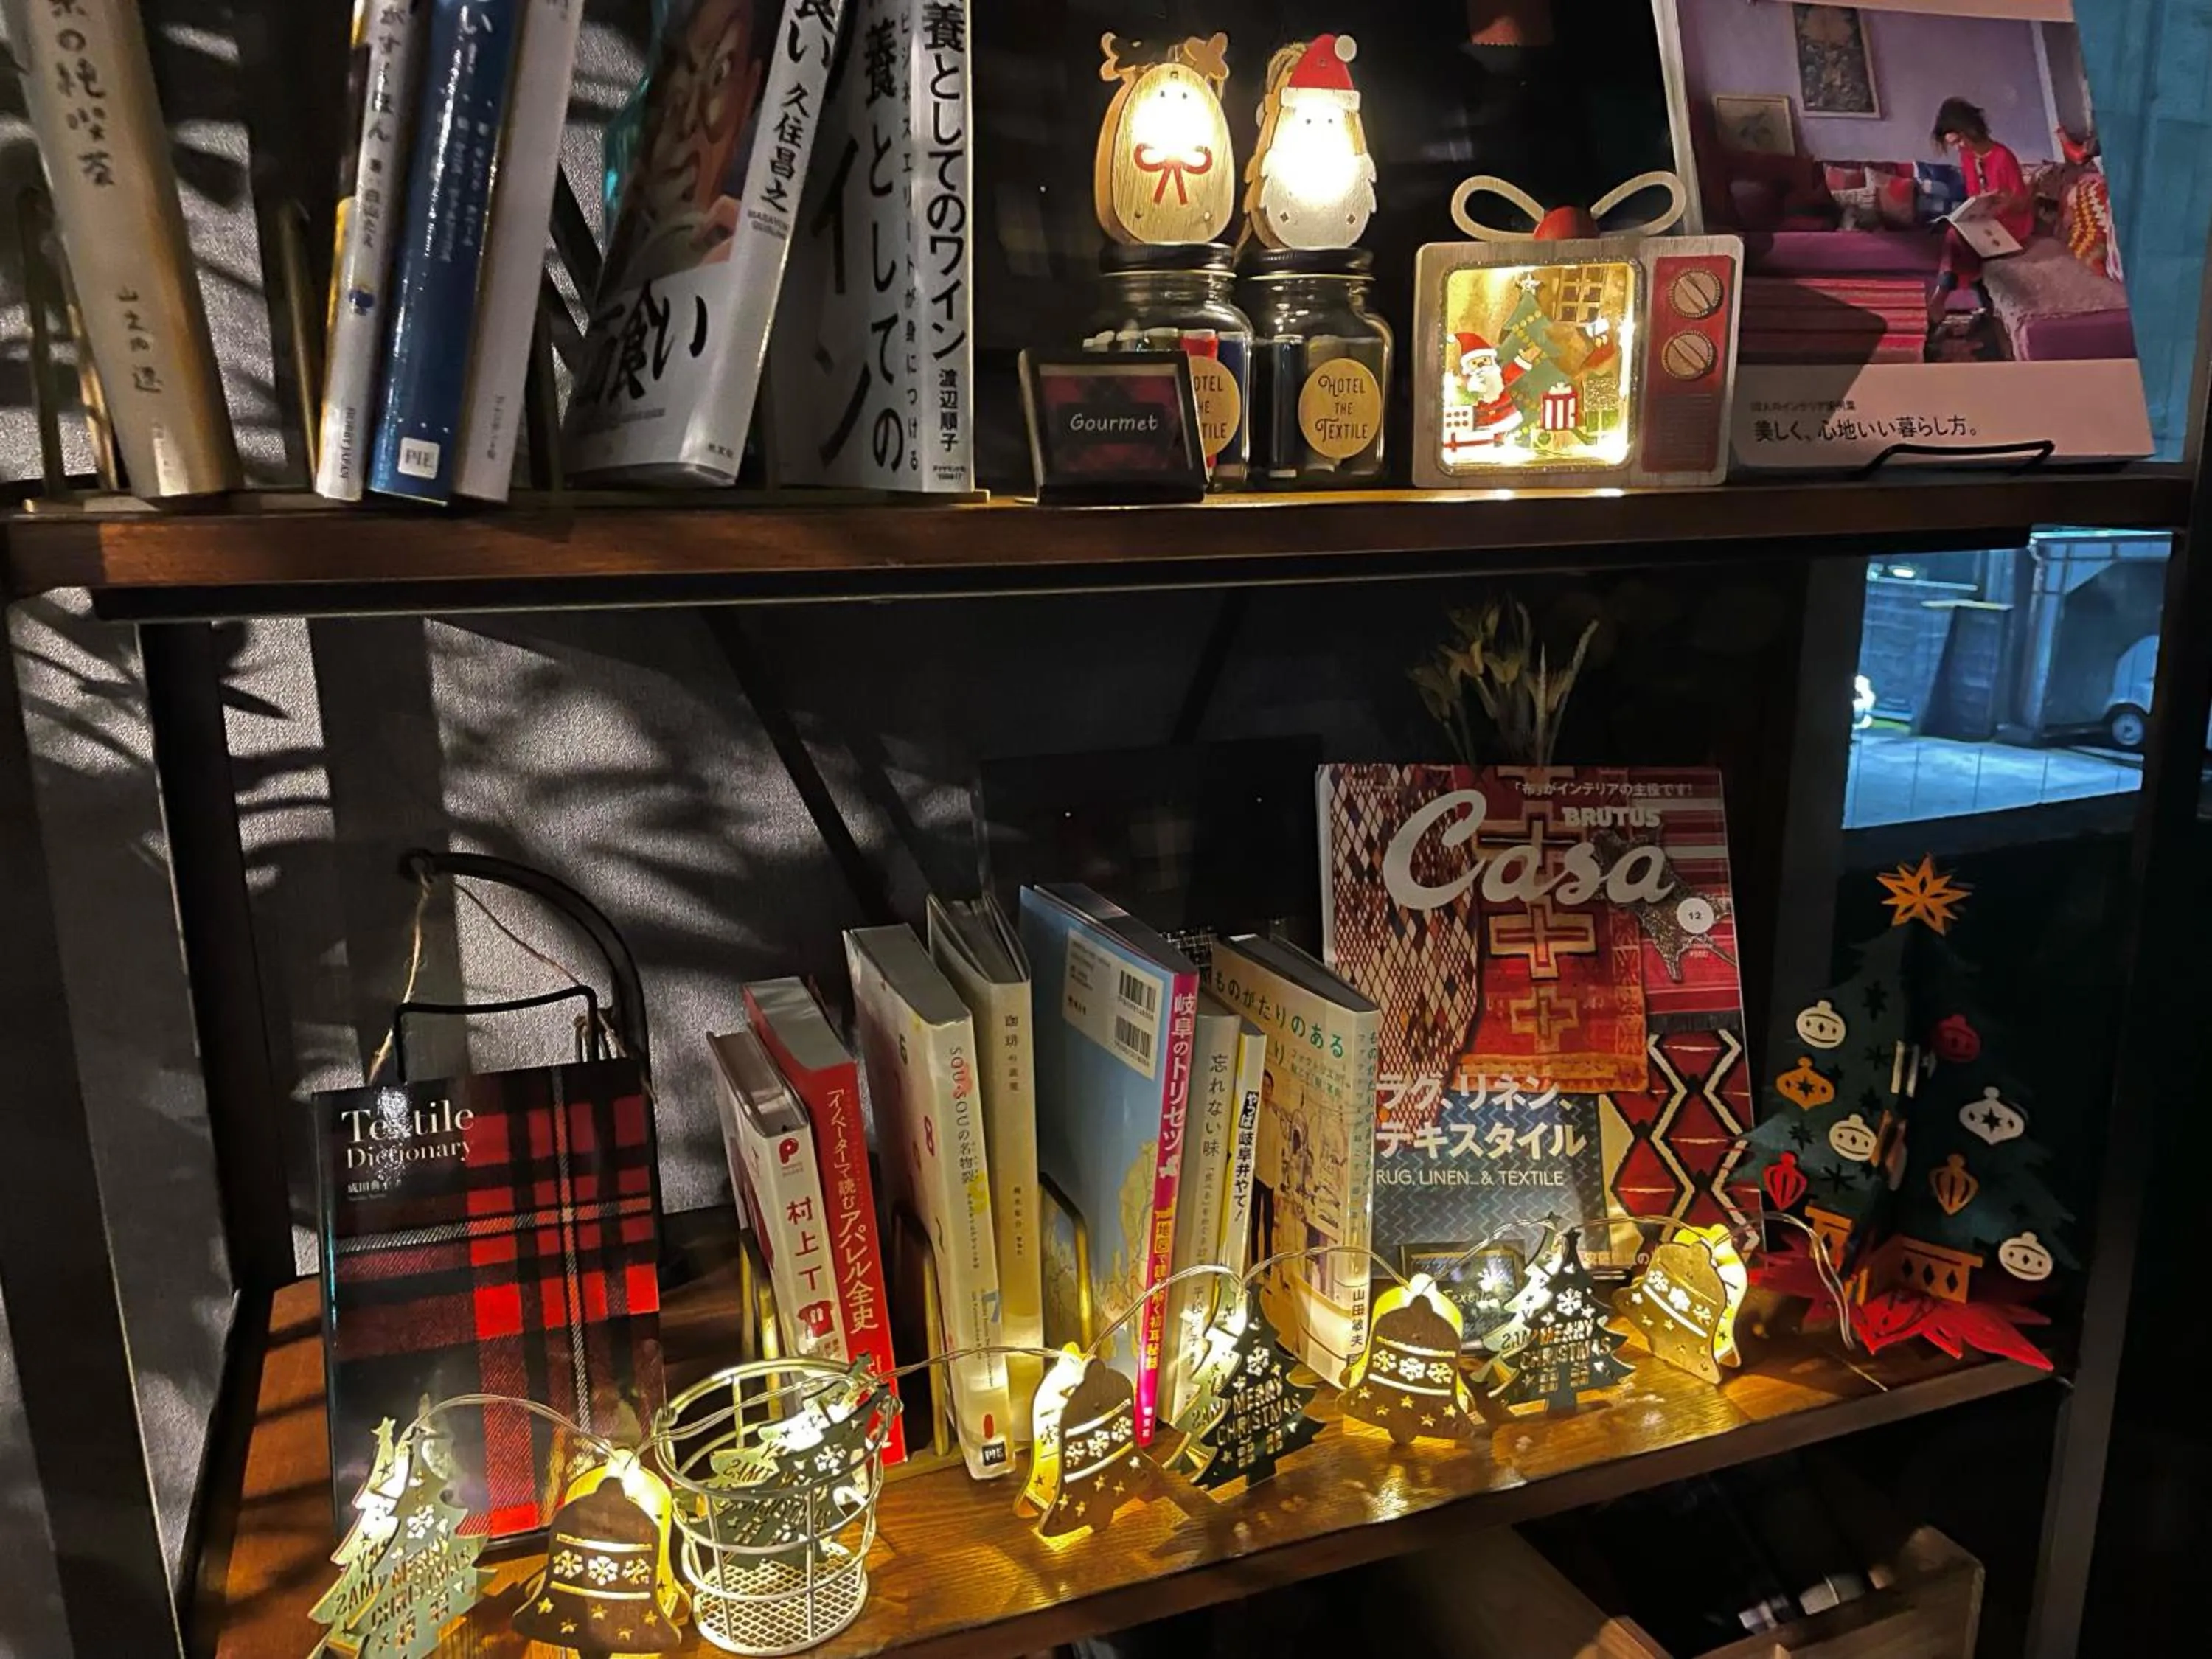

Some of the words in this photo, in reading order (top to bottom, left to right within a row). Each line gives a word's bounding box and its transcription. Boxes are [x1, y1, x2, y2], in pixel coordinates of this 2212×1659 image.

[760, 82, 810, 213] 久住昌之
[1193, 375, 1223, 392] OTEL
[1318, 374, 1366, 397] HOTEL
[939, 368, 959, 452] 渡辺順子
[1070, 414, 1158, 432] Gourmet
[1335, 402, 1354, 414] THE
[1315, 418, 1368, 443] TEXTILE
[1755, 415, 1978, 442] 美しく、心地いい暮らし方。
[406, 448, 433, 468] PIE
[1561, 806, 1663, 828] BRUTUS
[1381, 790, 1678, 913] Casa
[1688, 911, 1702, 920] 12
[1216, 971, 1344, 1060] ものがたりのある
[1162, 992, 1197, 1152] 岐阜のトリセツ
[1202, 1054, 1228, 1157] 忘れない味
[1374, 1071, 1572, 1110] ラグ、リネン、
[341, 1099, 474, 1143] Tetile
[1374, 1120, 1587, 1160] テキスタイル
[1481, 1169, 1495, 1186] &
[1498, 1169, 1565, 1186] TEXTILE
[839, 1210, 880, 1334] アパレル全史
[1350, 1288, 1365, 1348] 山田敏夫
[984, 1446, 1005, 1463] PIE
